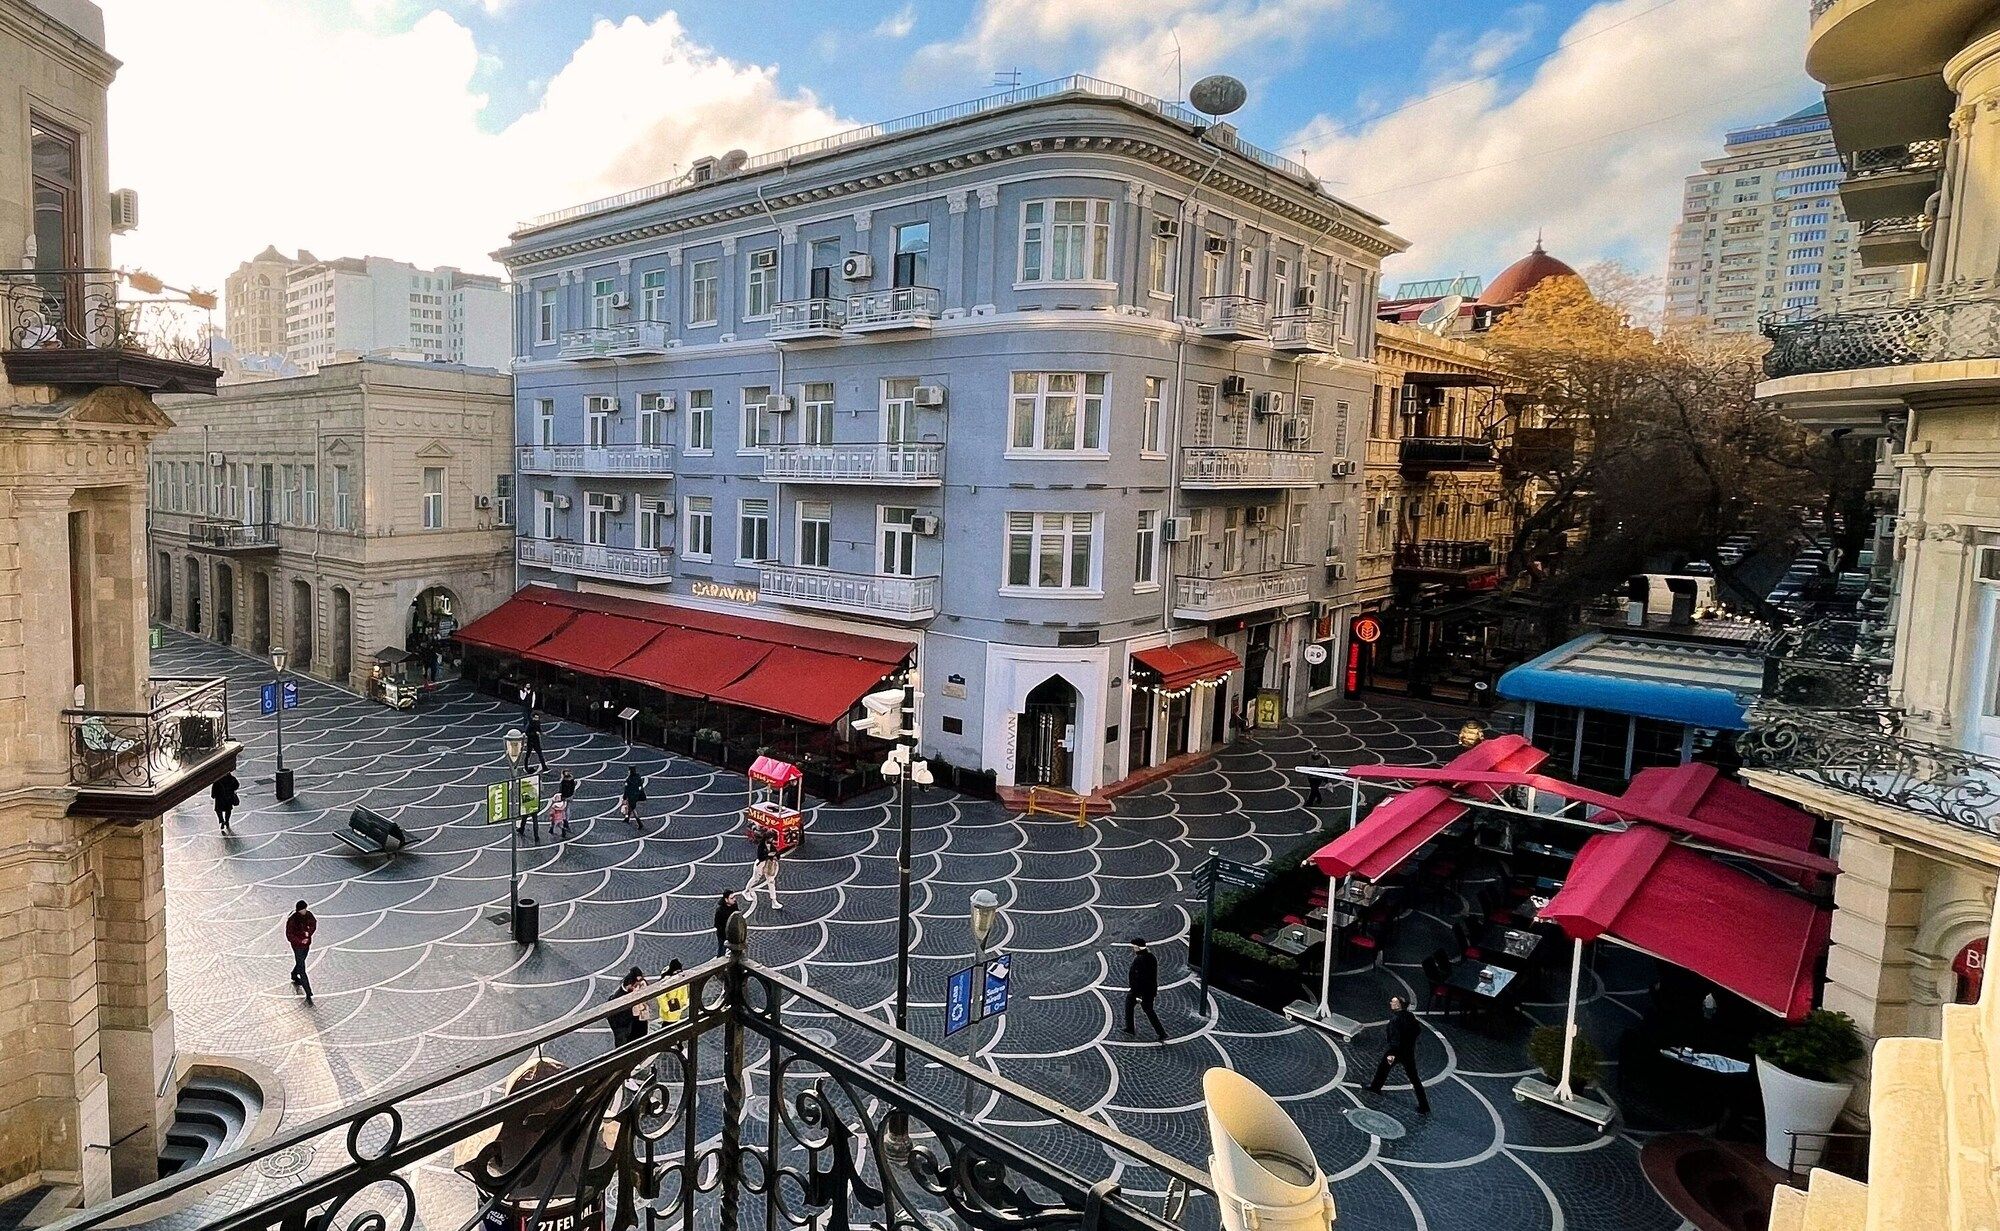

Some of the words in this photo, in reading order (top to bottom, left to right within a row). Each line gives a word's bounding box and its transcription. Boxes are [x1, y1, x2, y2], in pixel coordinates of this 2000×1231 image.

[692, 581, 757, 604] CARAVAN
[1006, 716, 1016, 770] CARAVAN
[748, 808, 780, 825] Midye
